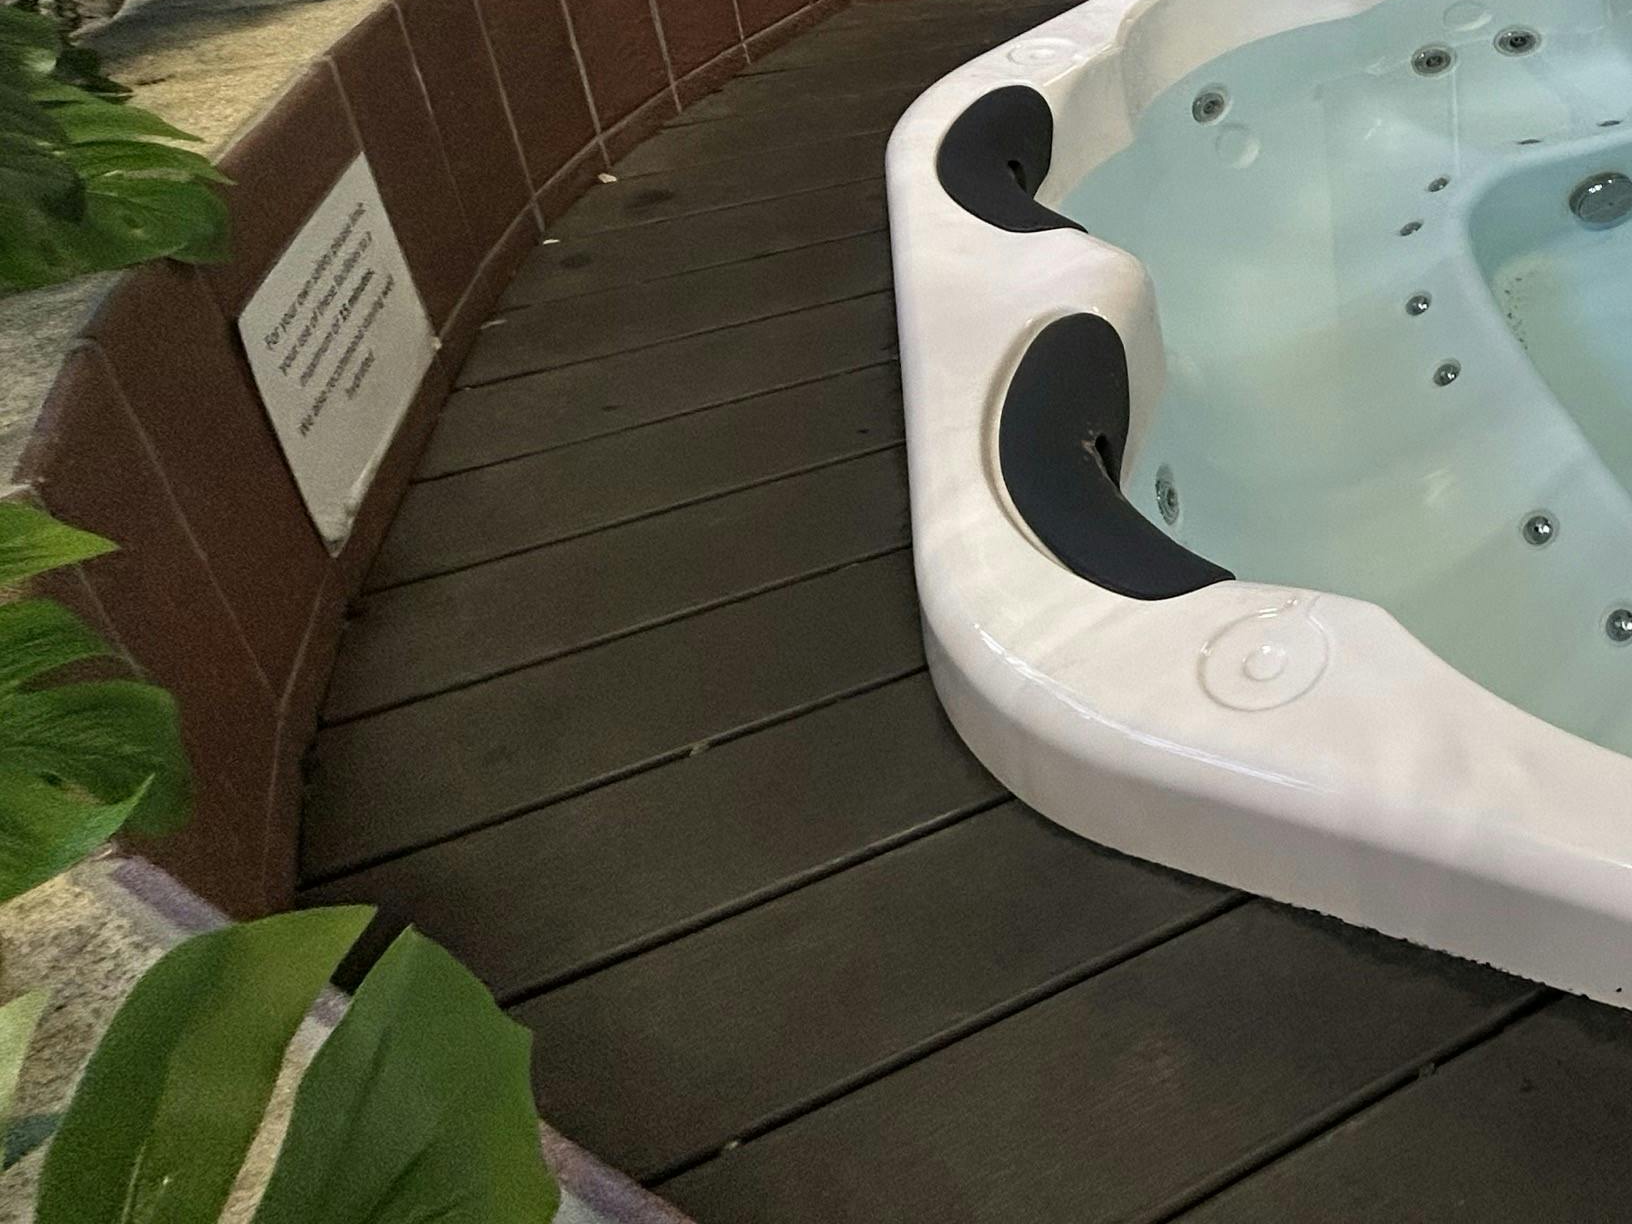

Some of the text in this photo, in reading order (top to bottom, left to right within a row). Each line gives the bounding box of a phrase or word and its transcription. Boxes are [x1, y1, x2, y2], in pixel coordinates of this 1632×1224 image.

[264, 327, 280, 351] For
[279, 302, 297, 333] your
[339, 303, 351, 323] 15
[279, 344, 299, 376] your
[297, 325, 312, 347] use
[310, 307, 319, 329] of
